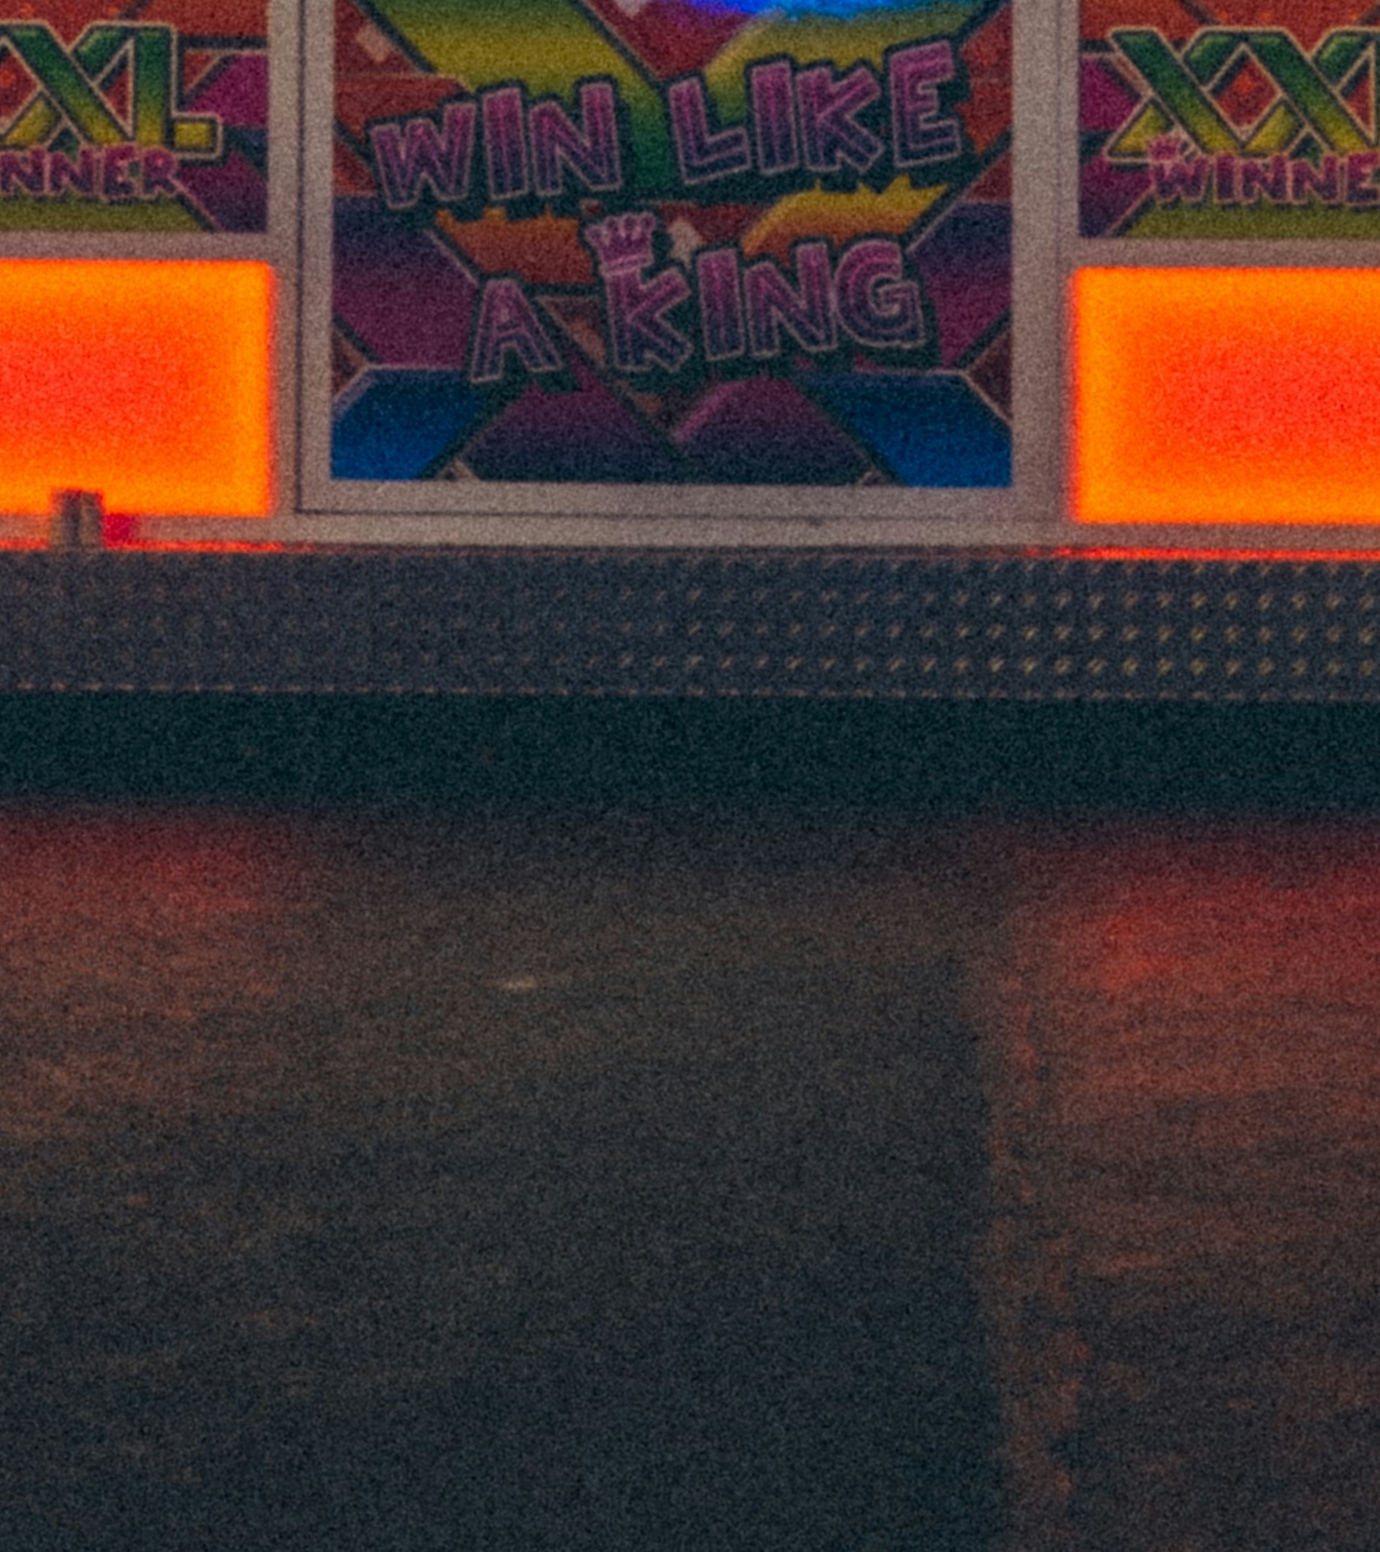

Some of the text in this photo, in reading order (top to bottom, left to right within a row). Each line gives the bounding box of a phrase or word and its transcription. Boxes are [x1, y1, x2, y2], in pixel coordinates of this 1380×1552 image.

[368, 40, 962, 210] WIN LIKE
[468, 238, 922, 384] A KING
